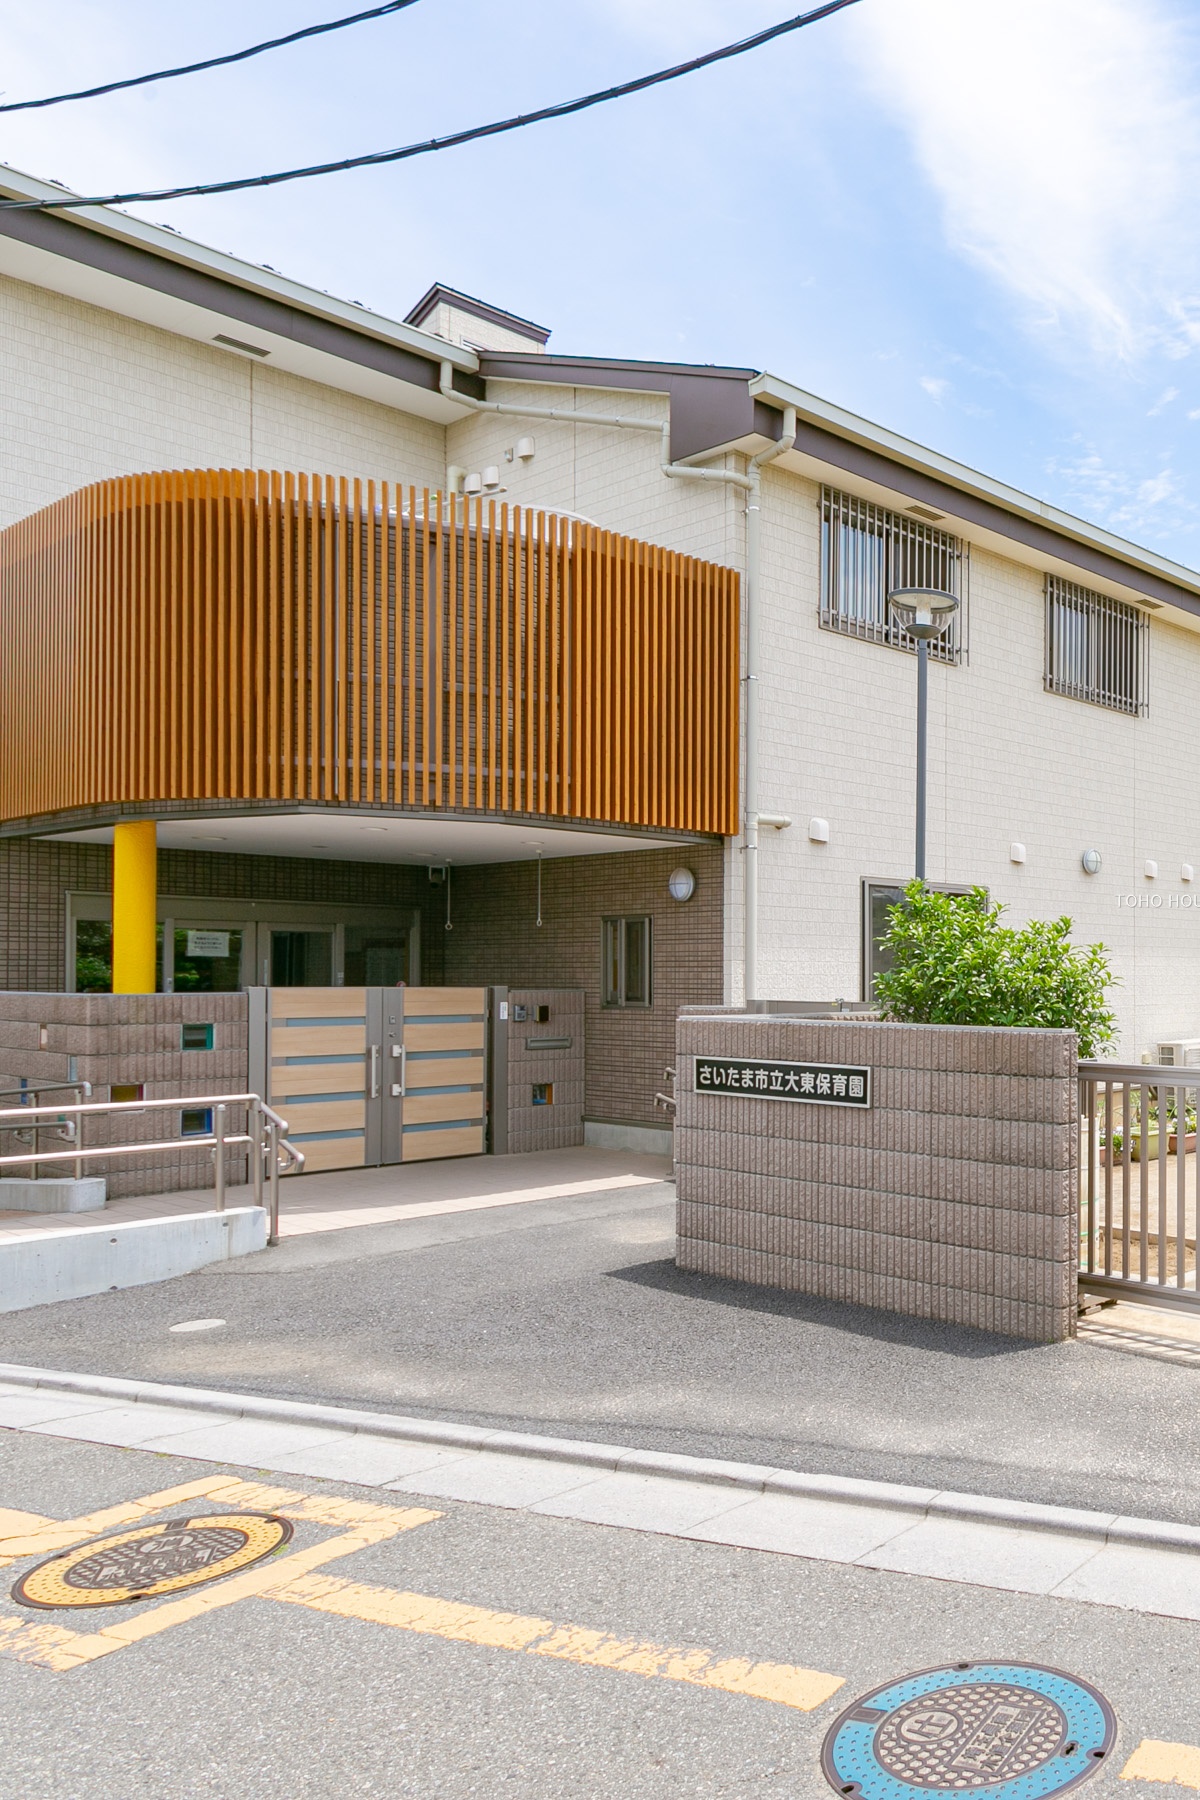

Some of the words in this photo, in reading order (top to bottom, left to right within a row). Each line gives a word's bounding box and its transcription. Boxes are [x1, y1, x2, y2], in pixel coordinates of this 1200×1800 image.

[699, 1065, 864, 1098] さいたま市立大東保育園
[958, 1711, 1014, 1761] 埼玉県南
[974, 1709, 1038, 1771] 水道企業団
